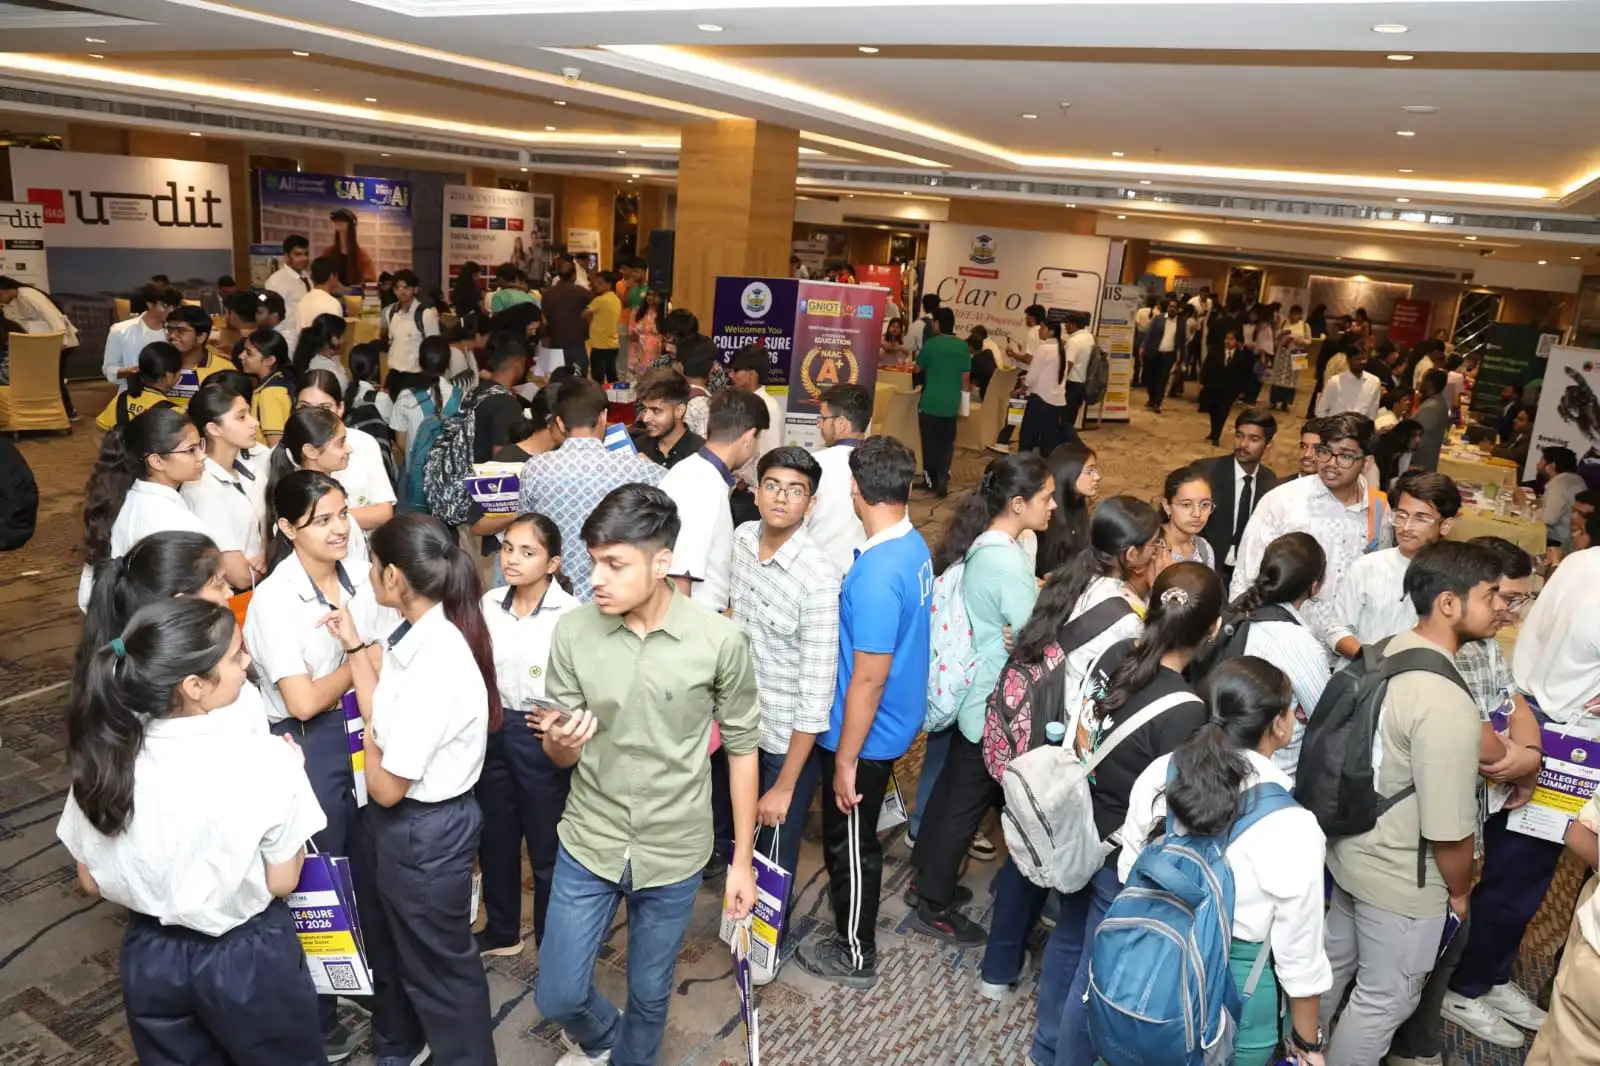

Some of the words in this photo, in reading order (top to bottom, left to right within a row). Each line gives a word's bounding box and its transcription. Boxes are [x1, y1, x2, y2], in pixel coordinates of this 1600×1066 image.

[69, 181, 223, 228] udit
[0, 208, 43, 229] dit
[808, 300, 840, 312] GNIOT
[724, 325, 767, 334] Welcomes
[767, 326, 782, 335] You
[814, 336, 852, 346] EDUCATION
[1537, 770, 1597, 789] OLLEGE4SU
[1537, 777, 1576, 793] SUMMIT
[306, 919, 332, 929] 2026
